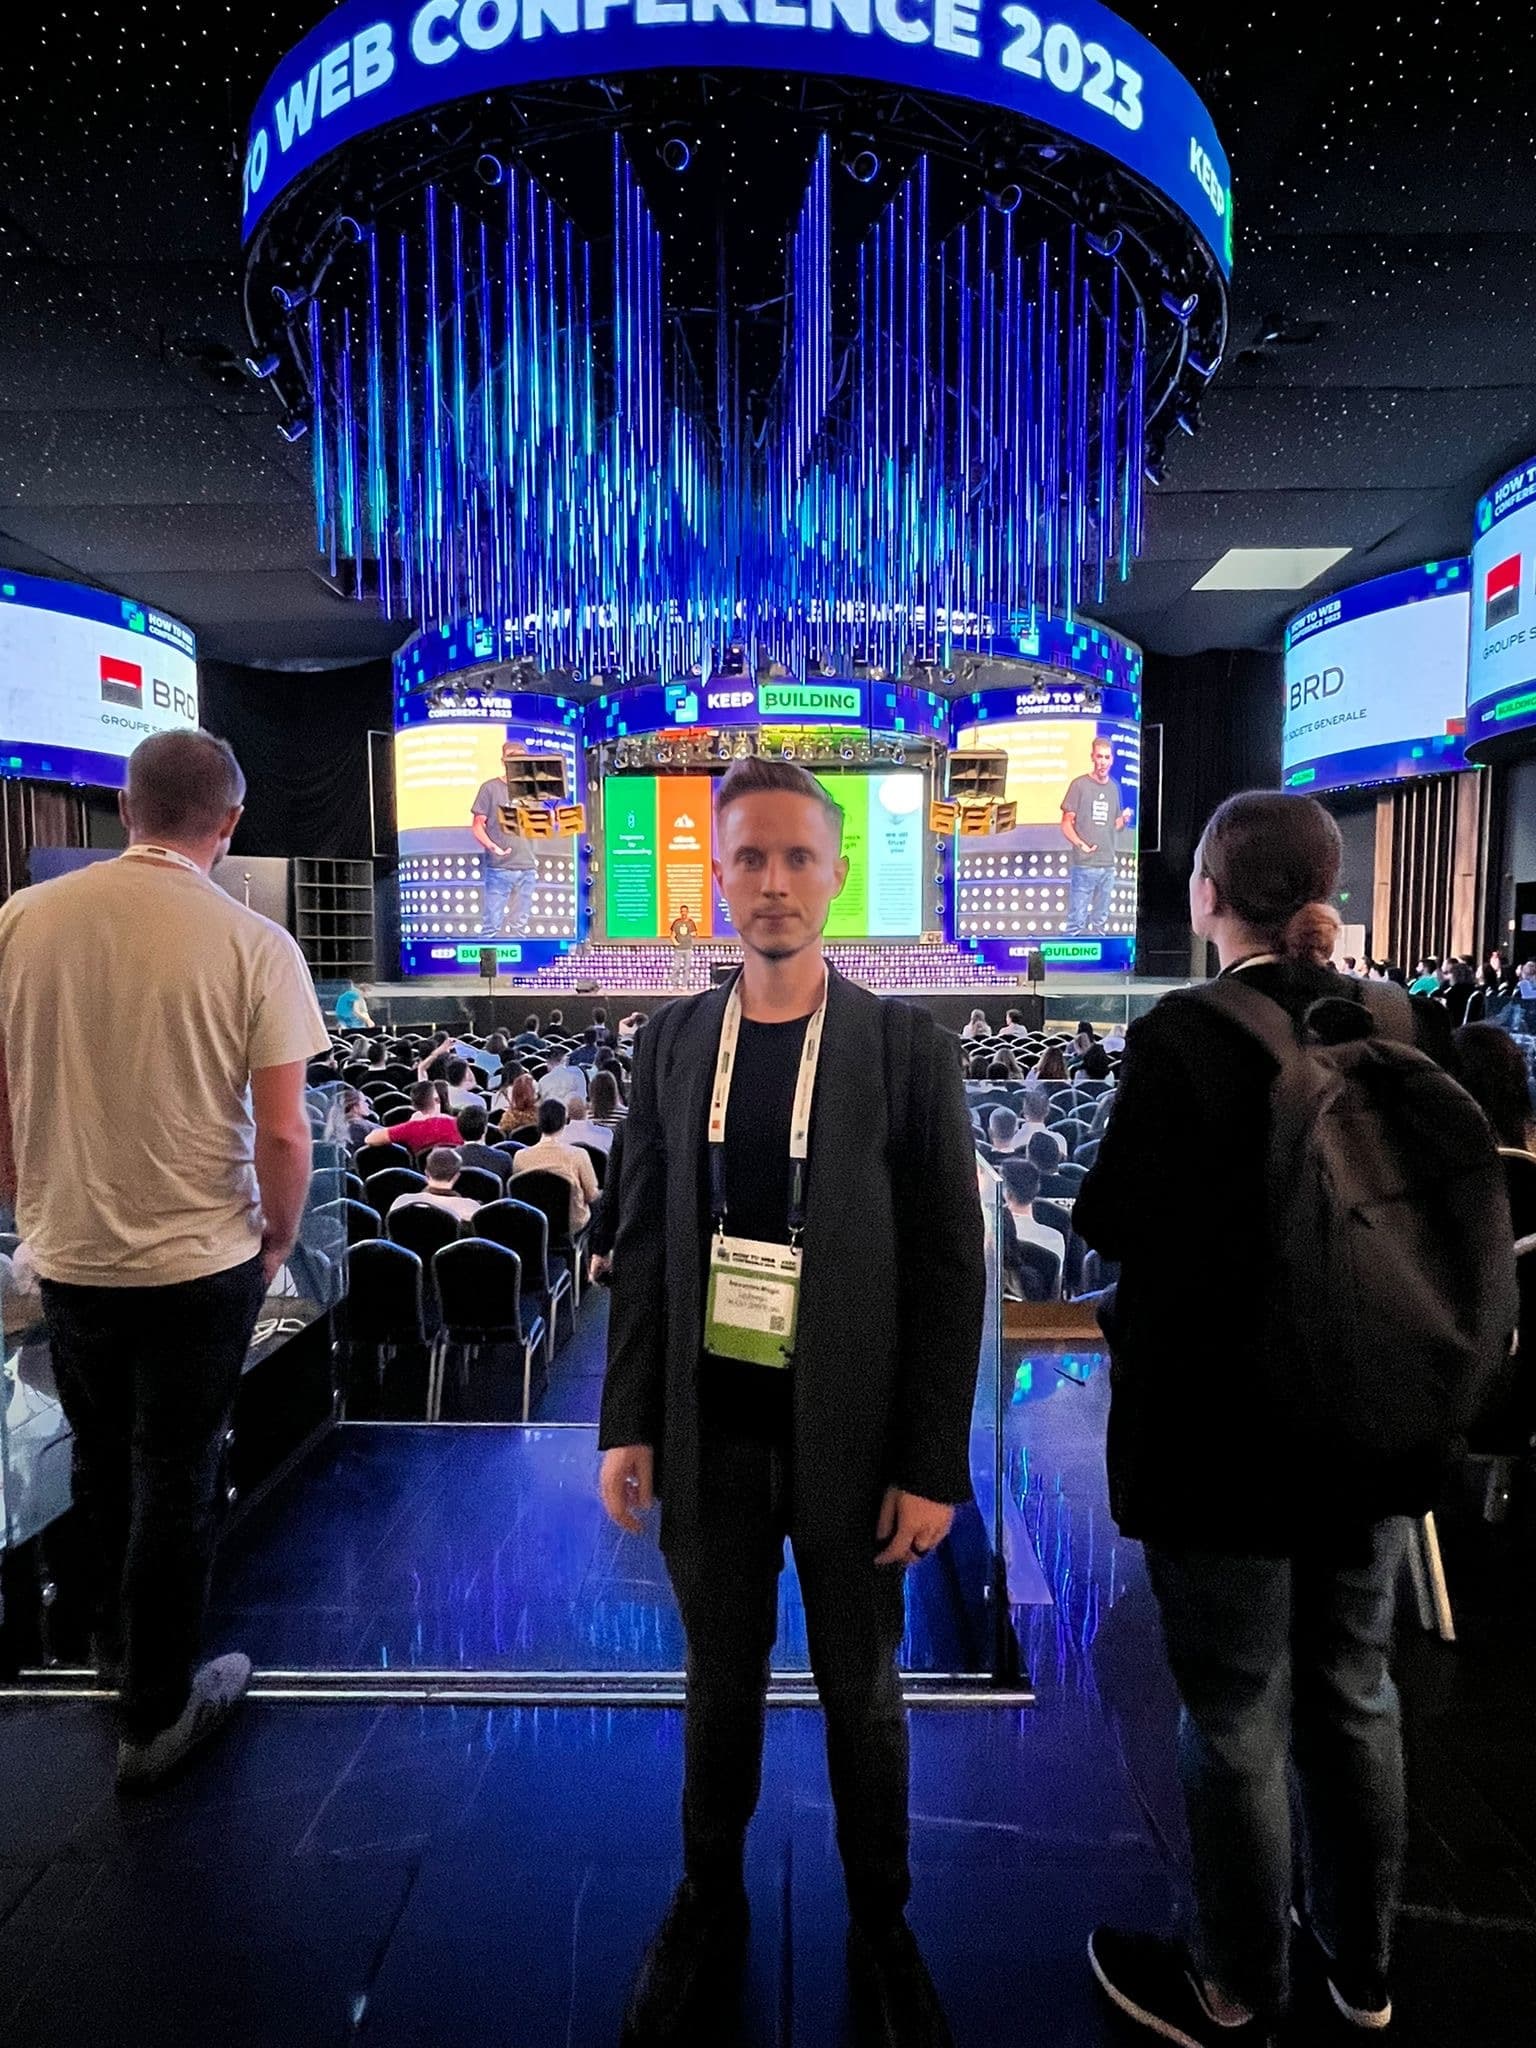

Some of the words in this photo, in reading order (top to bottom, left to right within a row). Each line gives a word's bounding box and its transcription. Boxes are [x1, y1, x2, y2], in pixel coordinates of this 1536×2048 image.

[275, 22, 395, 152] WEB
[1001, 6, 1143, 131] 2023
[1190, 136, 1225, 217] KEEP
[1495, 472, 1525, 505] HOW
[1482, 630, 1526, 660] GROUPE
[153, 678, 196, 721] BRD
[707, 692, 755, 709] KEEP
[765, 693, 855, 708] BUILDING
[1016, 693, 1051, 706] HOW
[1053, 692, 1072, 704] TO
[1290, 666, 1344, 711] BRD
[101, 714, 150, 734] GROUPE
[1016, 704, 1080, 715] CONFERENCE
[1314, 708, 1367, 730] GENERALE
